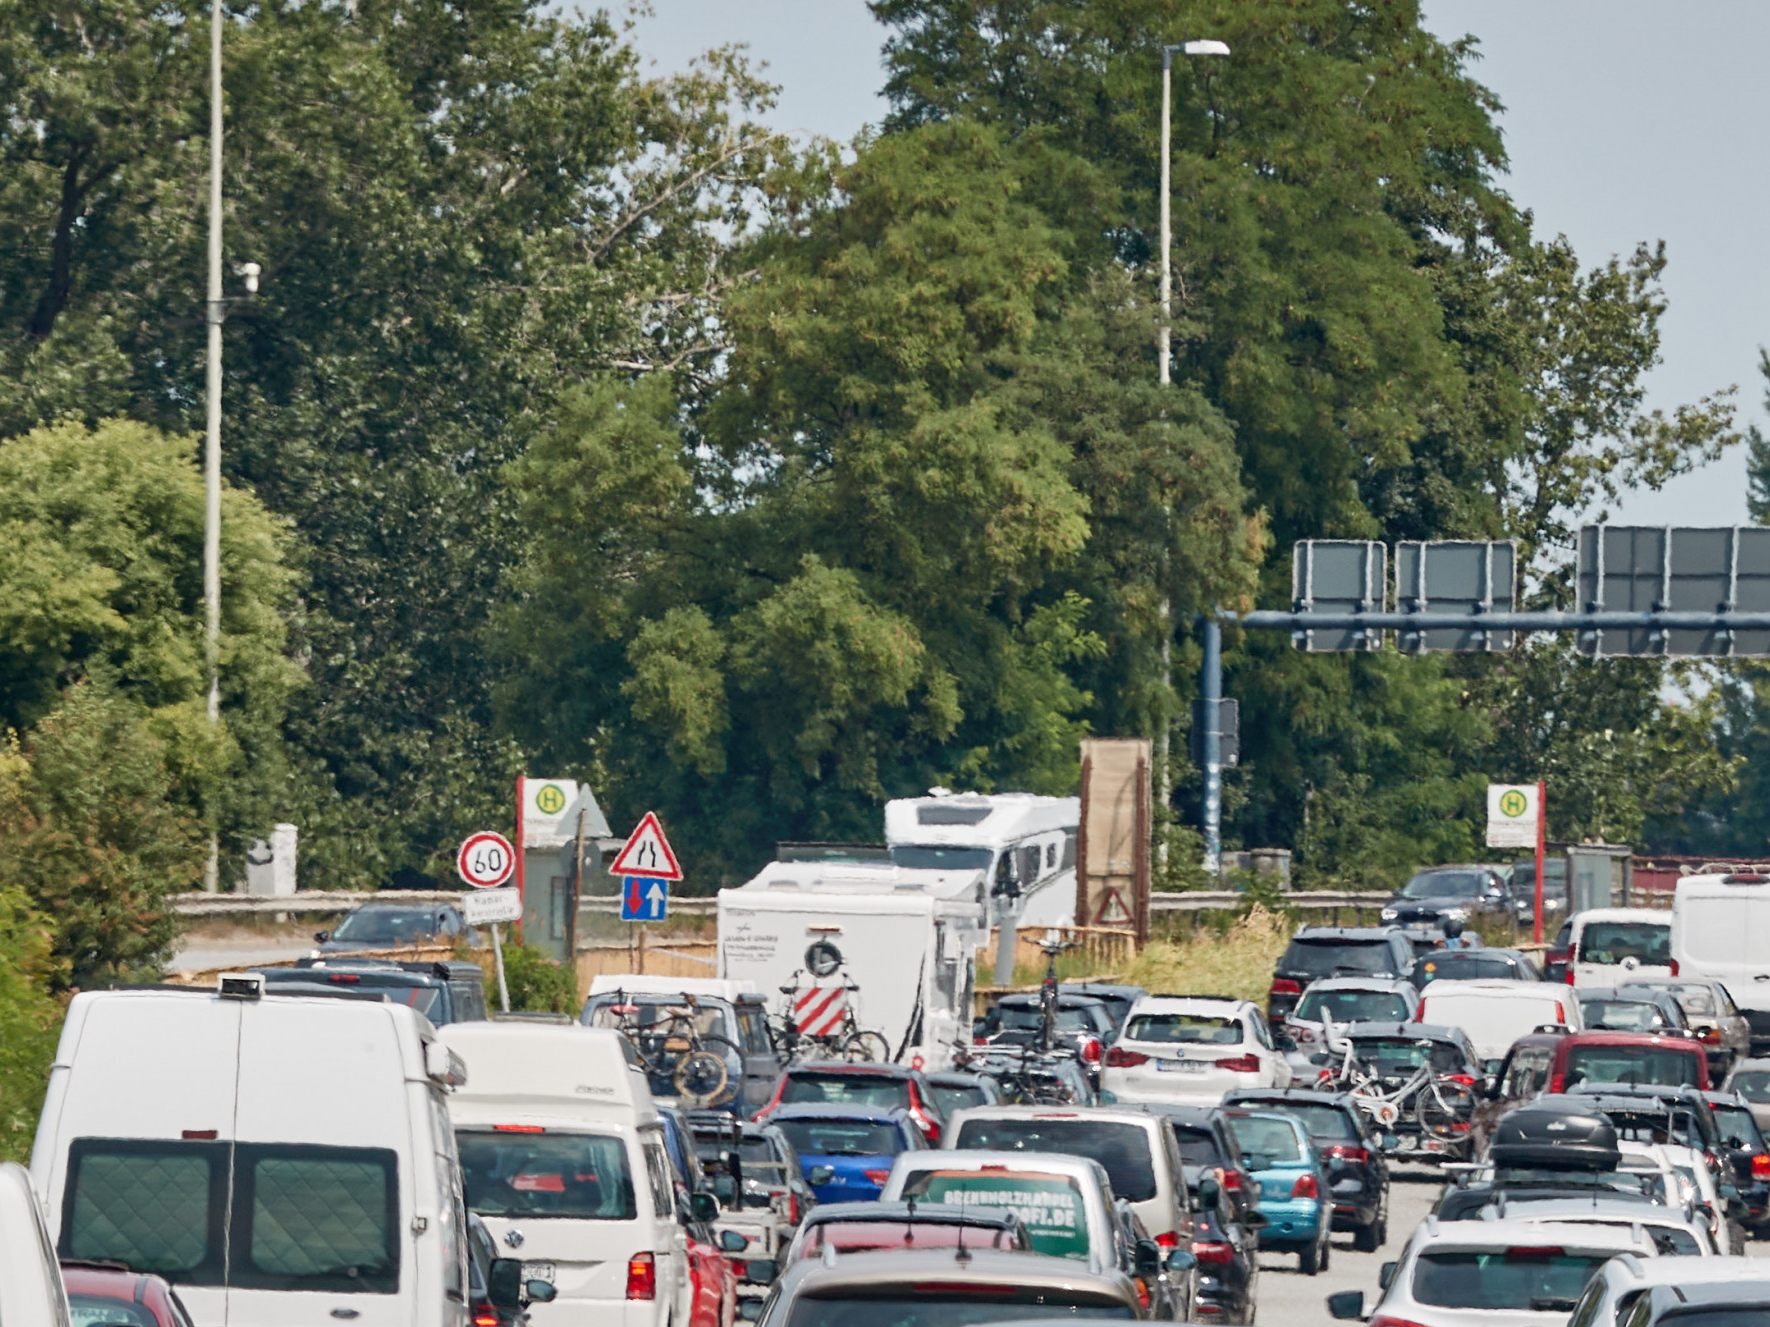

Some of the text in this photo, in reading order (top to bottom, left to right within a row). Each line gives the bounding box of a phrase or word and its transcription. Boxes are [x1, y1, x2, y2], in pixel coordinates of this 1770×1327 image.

[543, 791, 557, 808] H
[1507, 795, 1520, 812] H
[474, 848, 502, 874] 60
[944, 1190, 1074, 1208] BRENNHOLZHANDEL
